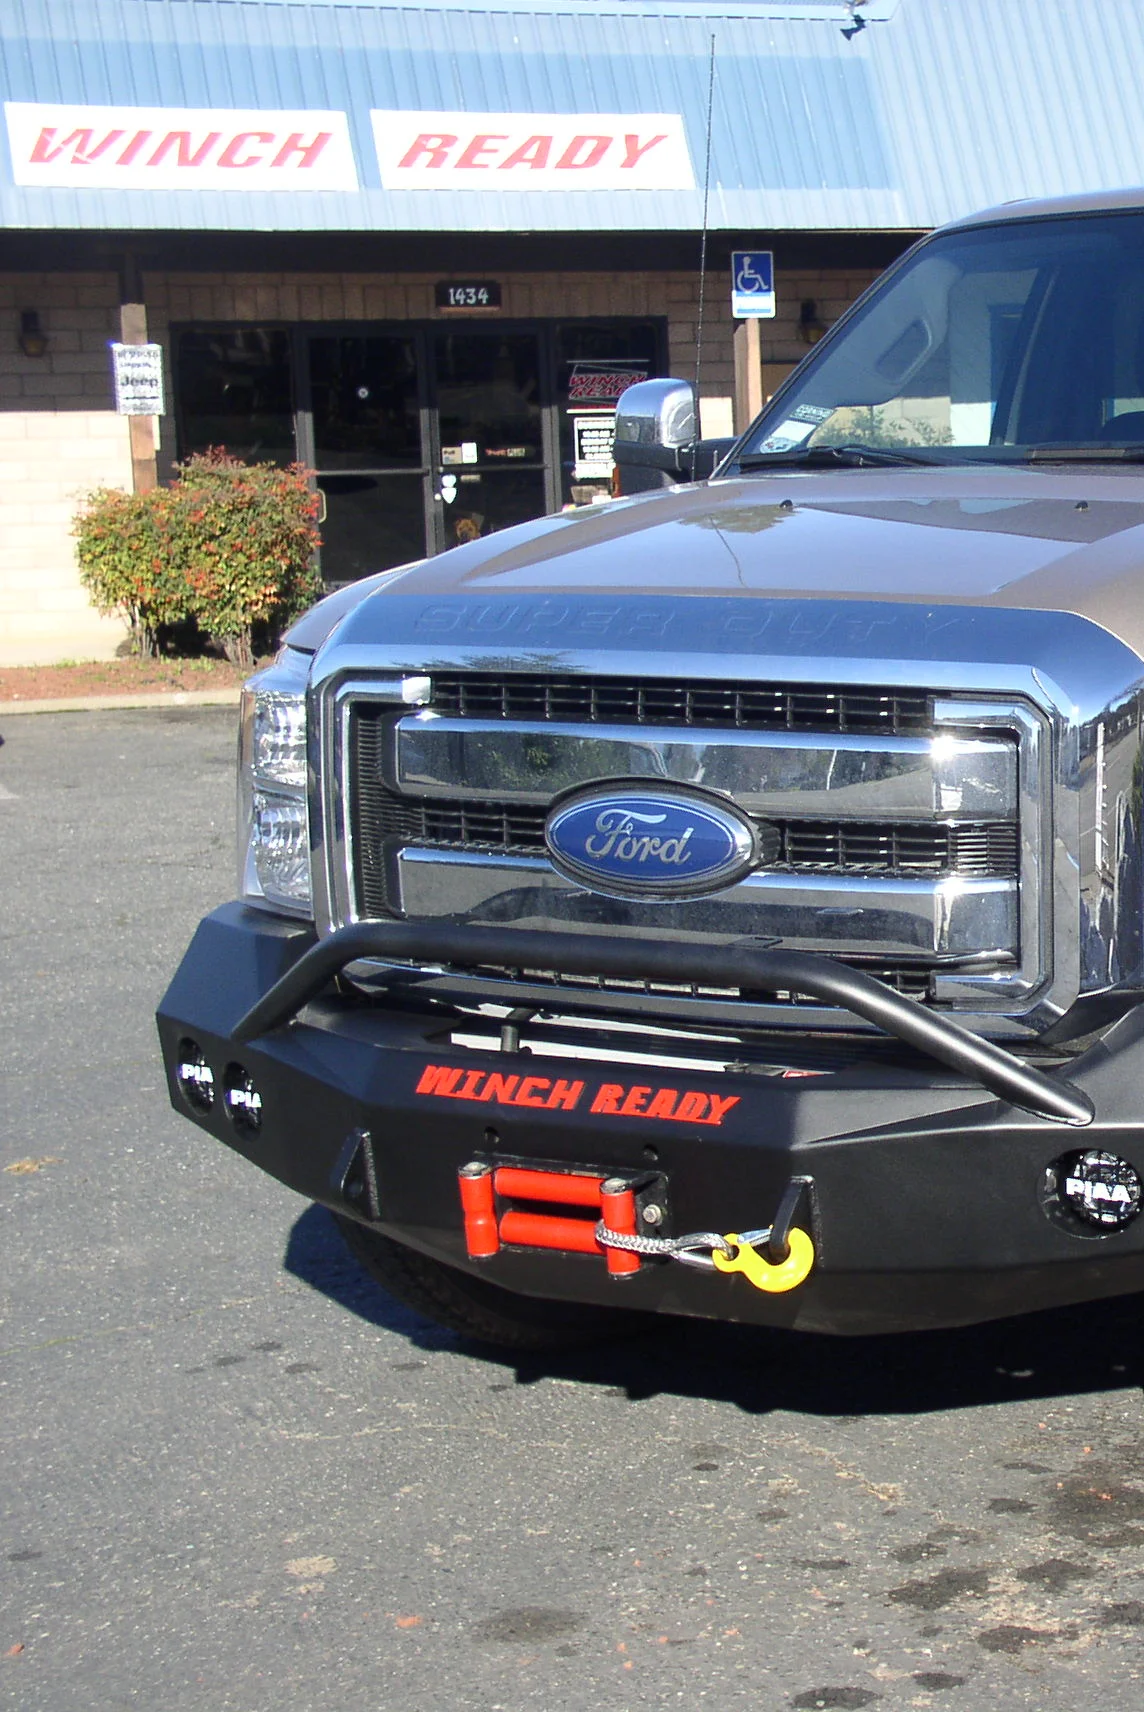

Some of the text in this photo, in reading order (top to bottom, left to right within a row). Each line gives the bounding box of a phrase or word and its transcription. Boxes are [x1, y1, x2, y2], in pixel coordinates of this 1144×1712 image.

[29, 127, 669, 169] WINCH READY
[448, 287, 489, 305] 1434
[415, 602, 965, 643] SUPER DUTY
[586, 808, 694, 864] Ford
[415, 1064, 741, 1125] WINCH READY
[1066, 1177, 1131, 1203] PIAA
